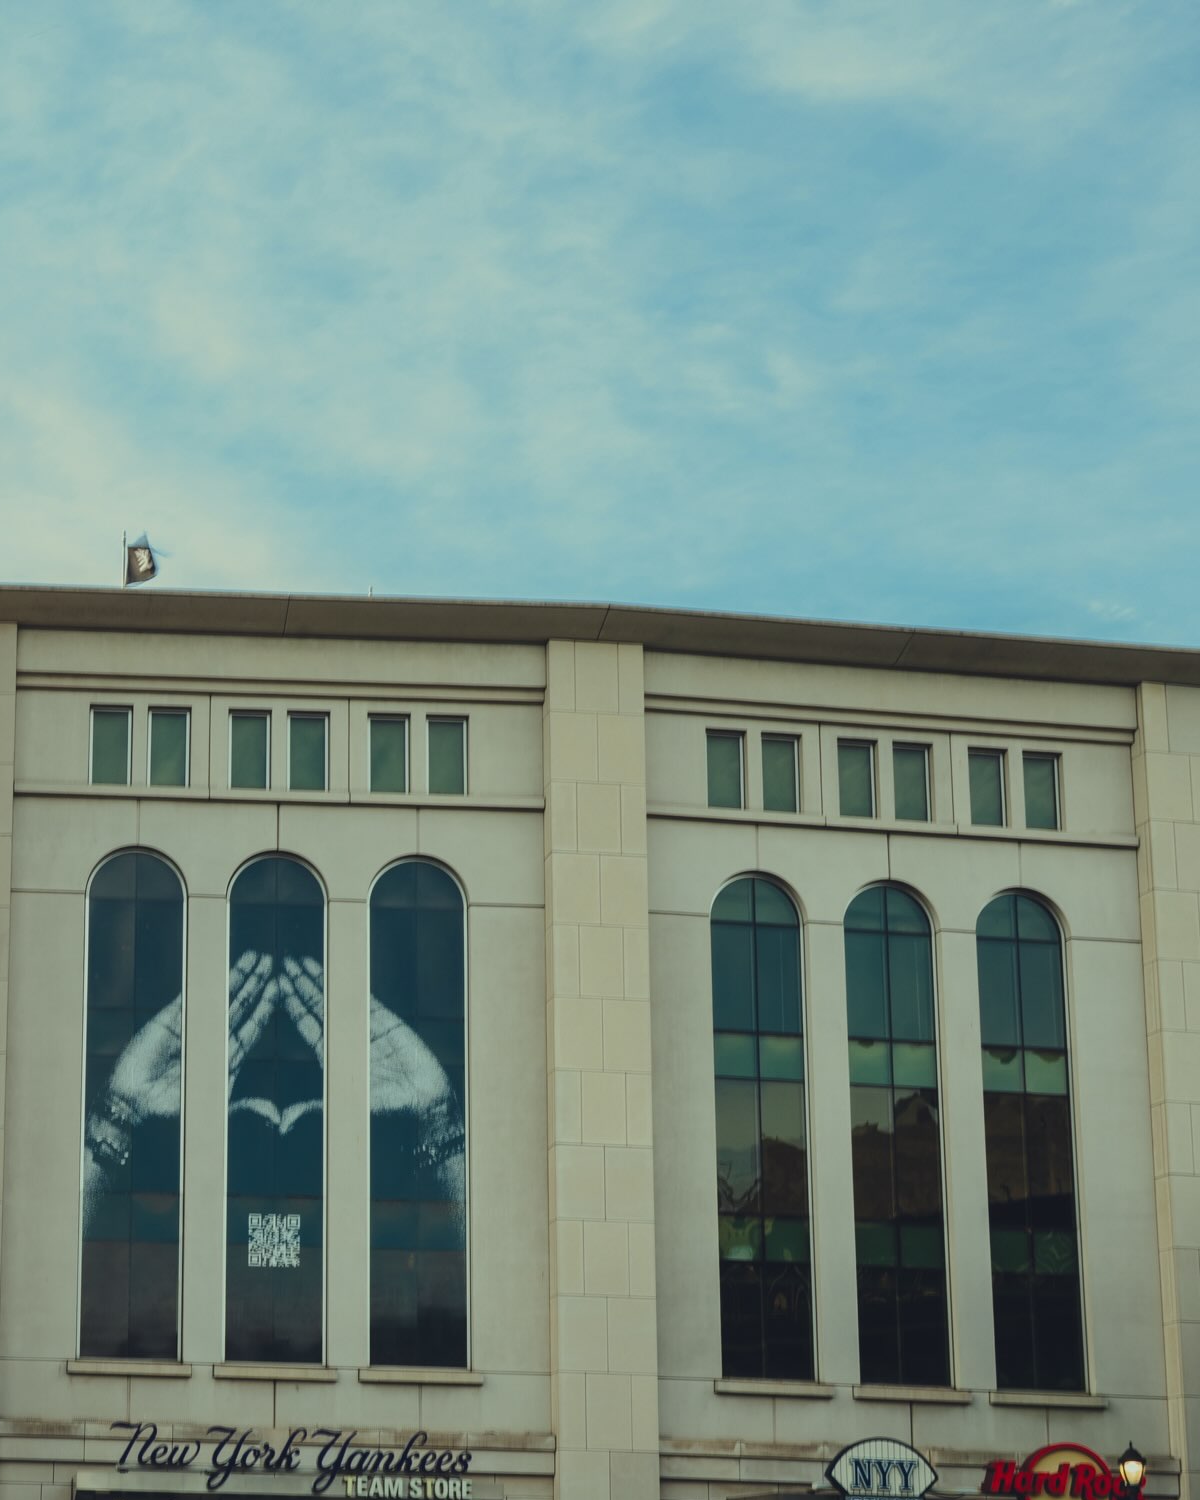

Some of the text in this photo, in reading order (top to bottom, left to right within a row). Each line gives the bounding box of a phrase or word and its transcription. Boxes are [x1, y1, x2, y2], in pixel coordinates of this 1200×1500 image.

[110, 1421, 473, 1494] New York Yankees
[850, 1457, 918, 1491] NYY
[343, 1475, 473, 1500] TEAM STORE
[987, 1460, 1071, 1497] Hard
